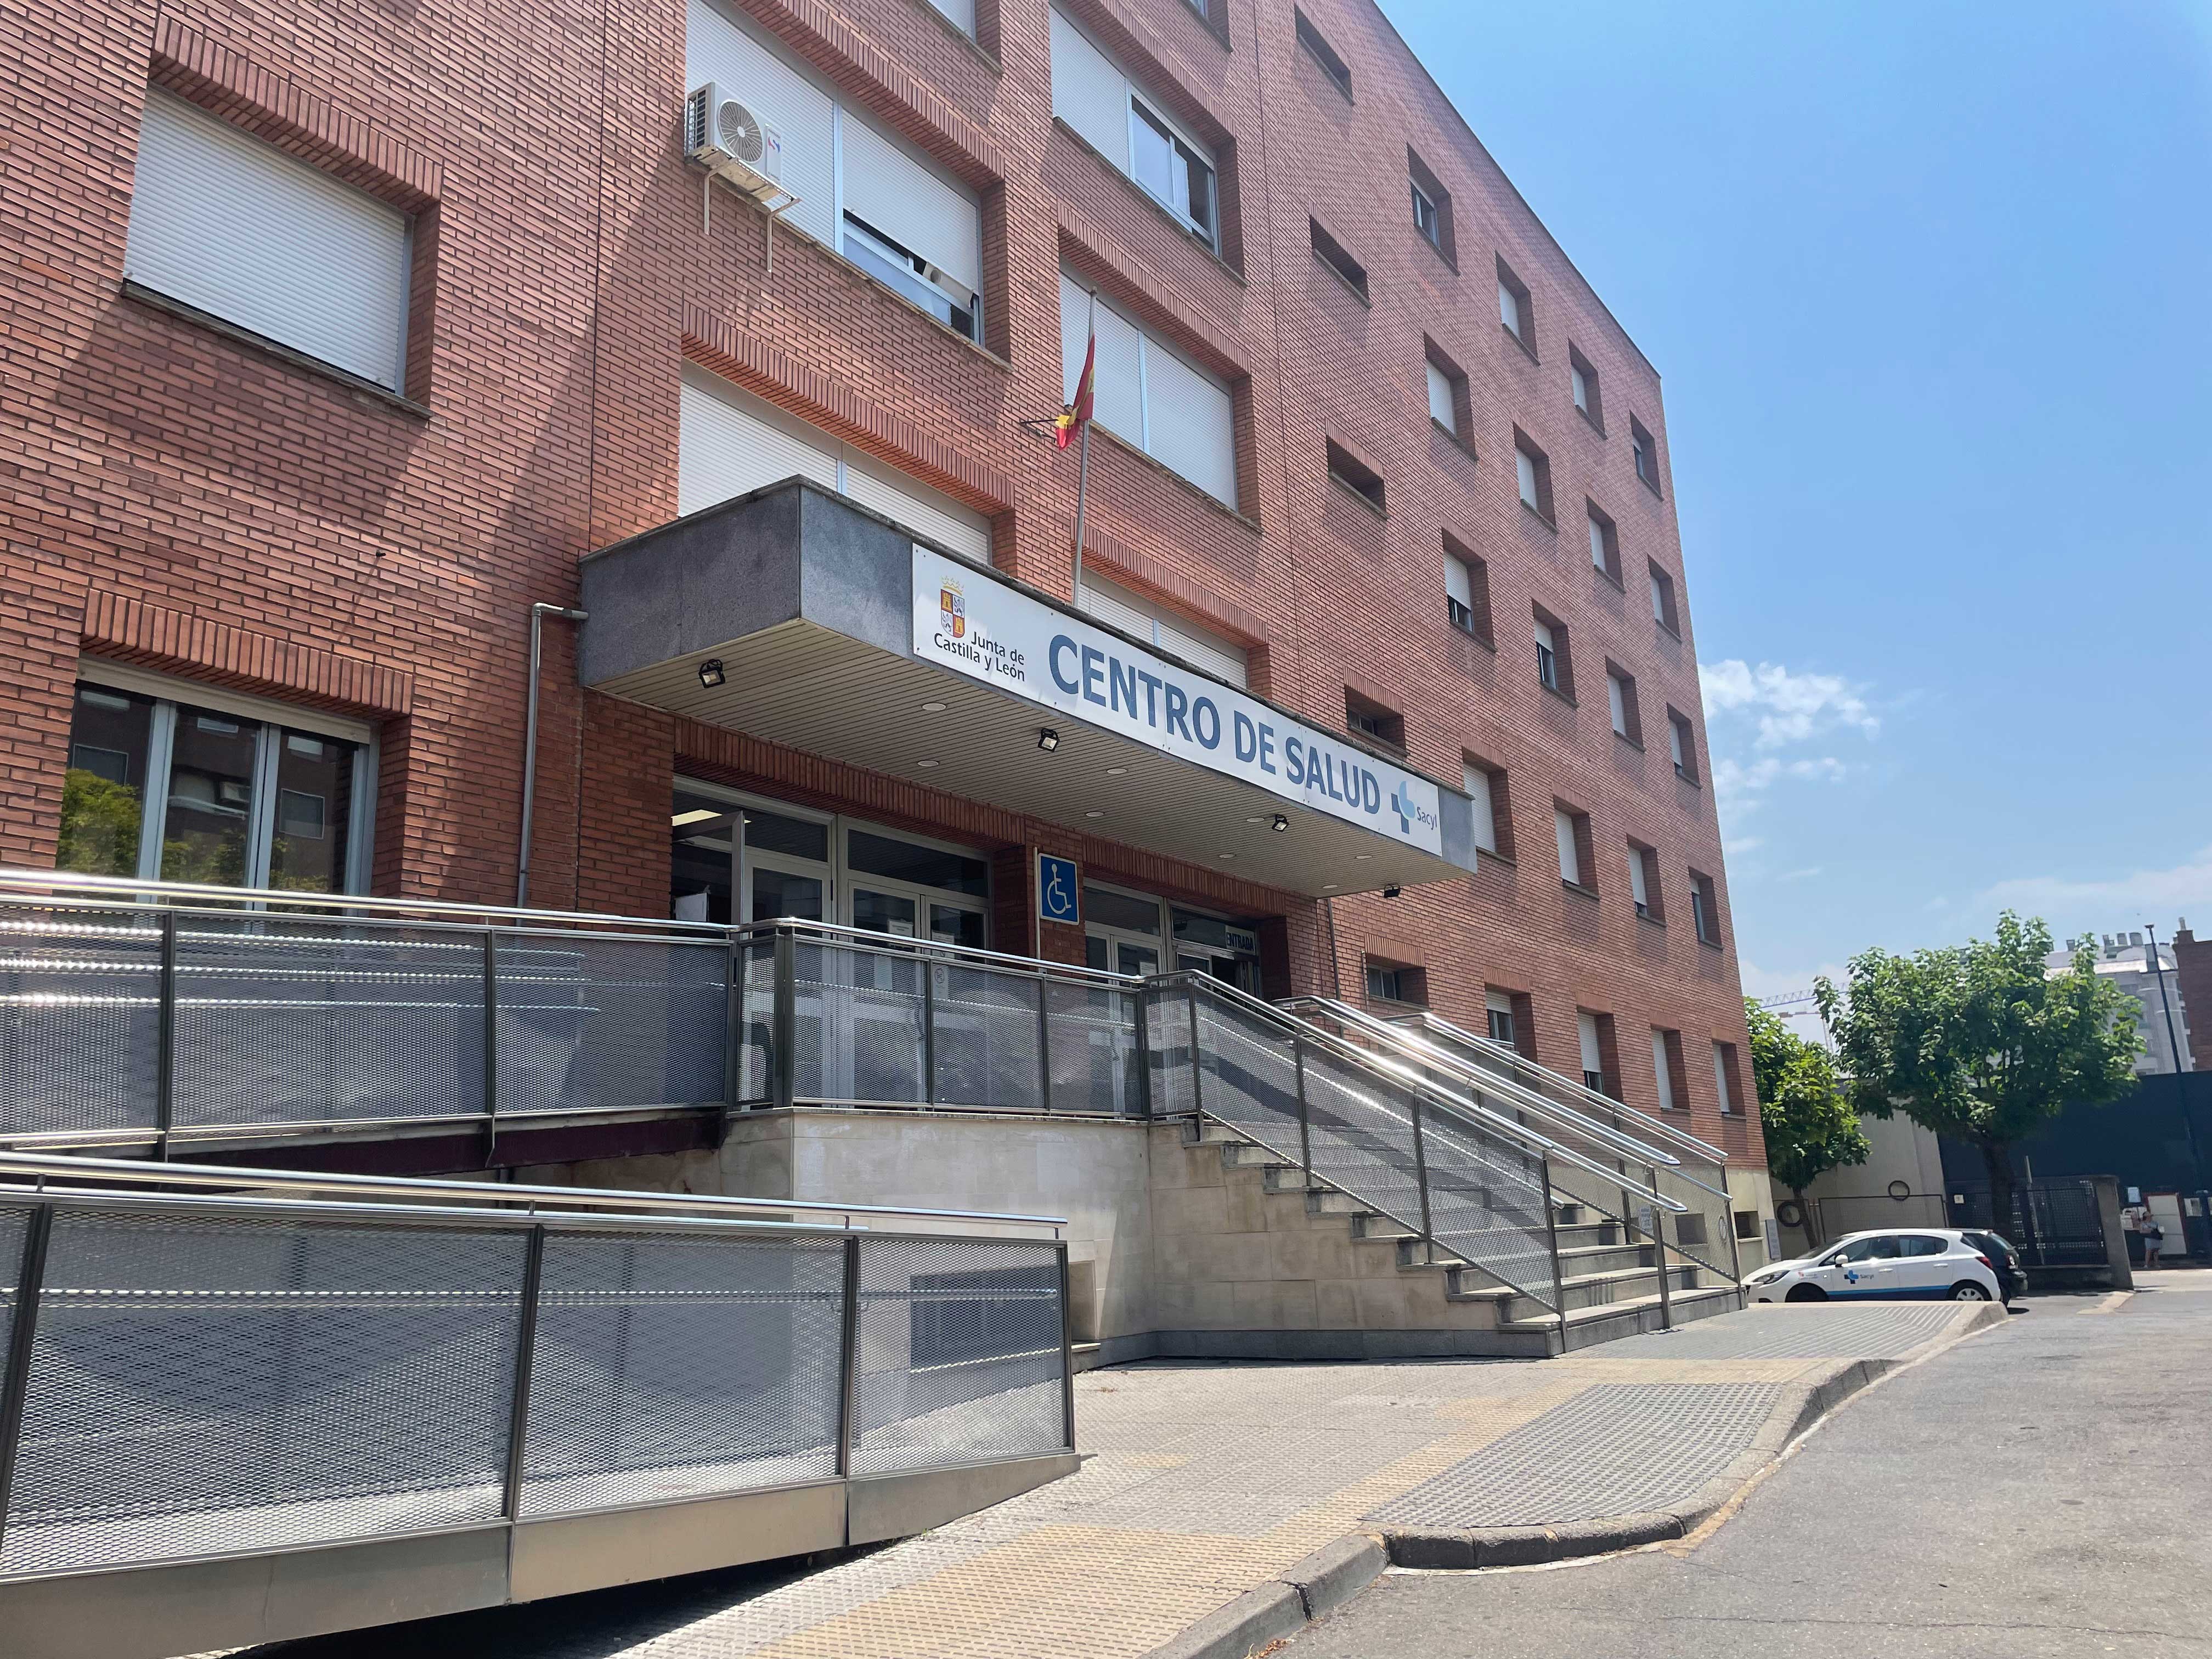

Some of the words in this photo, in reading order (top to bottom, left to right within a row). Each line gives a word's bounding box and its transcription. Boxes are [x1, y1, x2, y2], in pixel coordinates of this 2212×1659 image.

[934, 633, 980, 663] Castilla
[984, 655, 992, 672] y
[996, 657, 1025, 682] León
[970, 631, 1006, 658] Junta
[1010, 648, 1024, 665] de
[1049, 634, 1221, 750] CENTRO
[1234, 710, 1276, 775] DE
[1285, 736, 1380, 814] SALUD
[1417, 806, 1437, 830] Sacyl
[1226, 932, 1255, 951] ENTRADA
